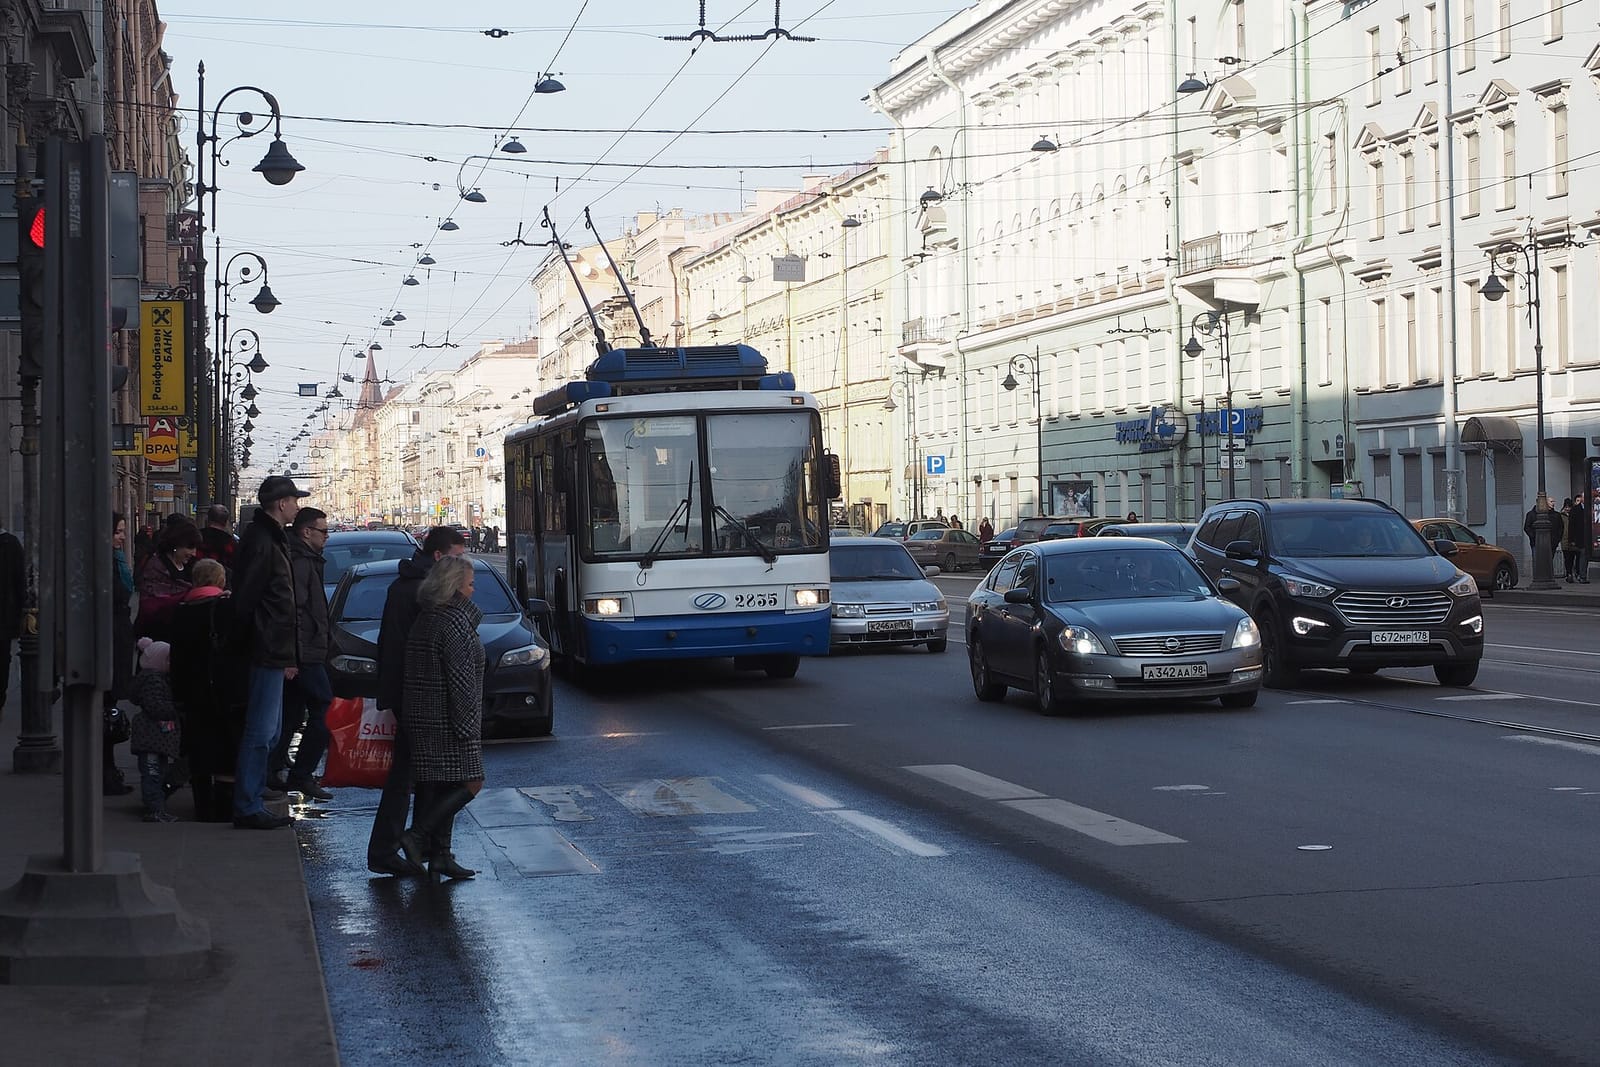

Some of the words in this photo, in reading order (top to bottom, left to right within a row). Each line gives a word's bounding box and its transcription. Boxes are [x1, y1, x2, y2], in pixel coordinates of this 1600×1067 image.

[163, 330, 173, 362] БАНК
[152, 328, 163, 400] Райффайзен
[145, 444, 178, 454] ВРАЧ
[1148, 667, 1190, 678] А342АА
[1192, 665, 1203, 674] 98
